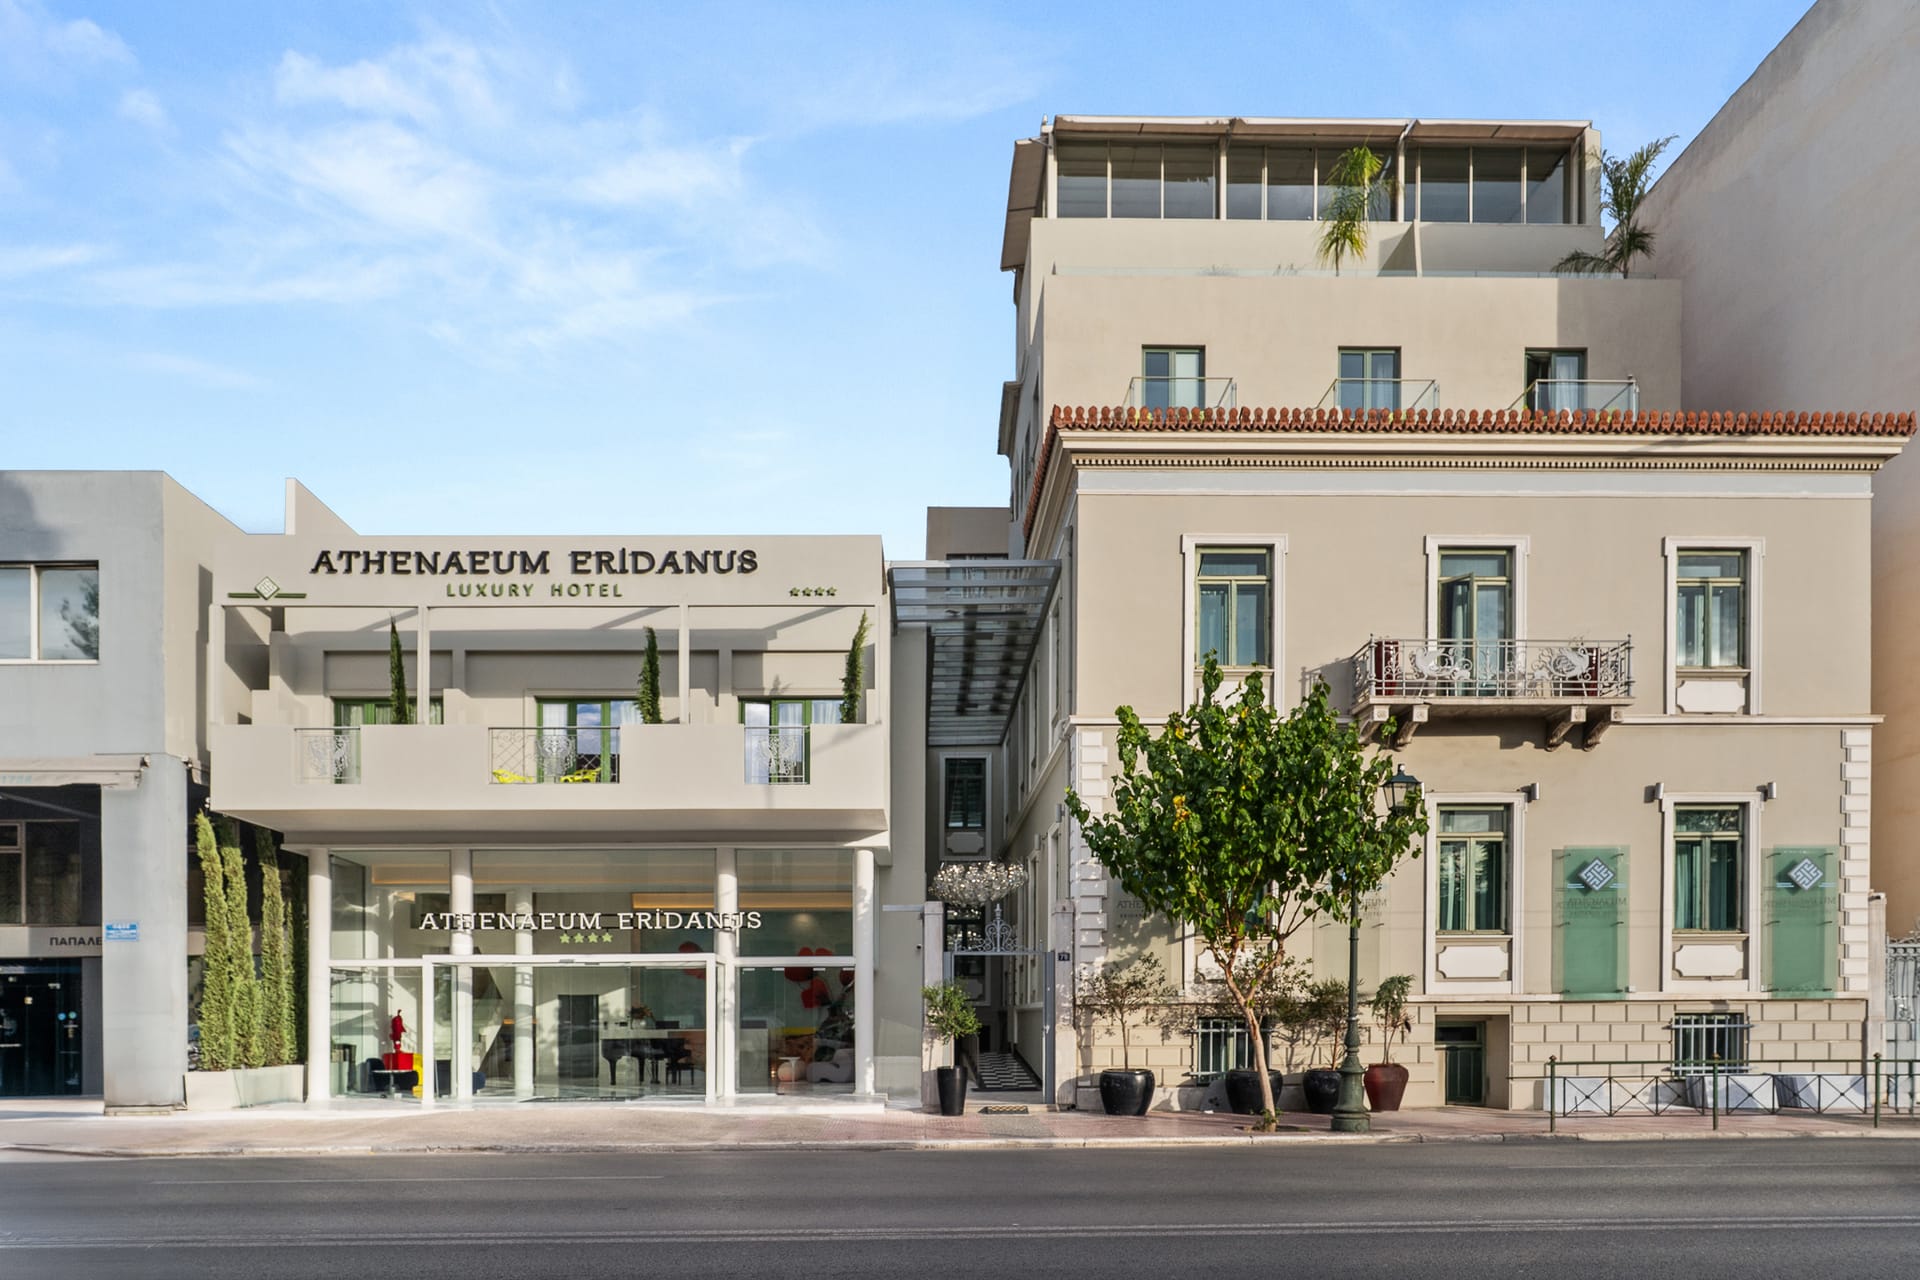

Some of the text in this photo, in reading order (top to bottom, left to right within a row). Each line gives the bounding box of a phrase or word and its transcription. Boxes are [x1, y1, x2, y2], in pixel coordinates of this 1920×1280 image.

[309, 549, 550, 575] ATHENAEUM
[446, 583, 623, 598] LUXURY HOTEL
[418, 912, 602, 930] ATHENAEUM
